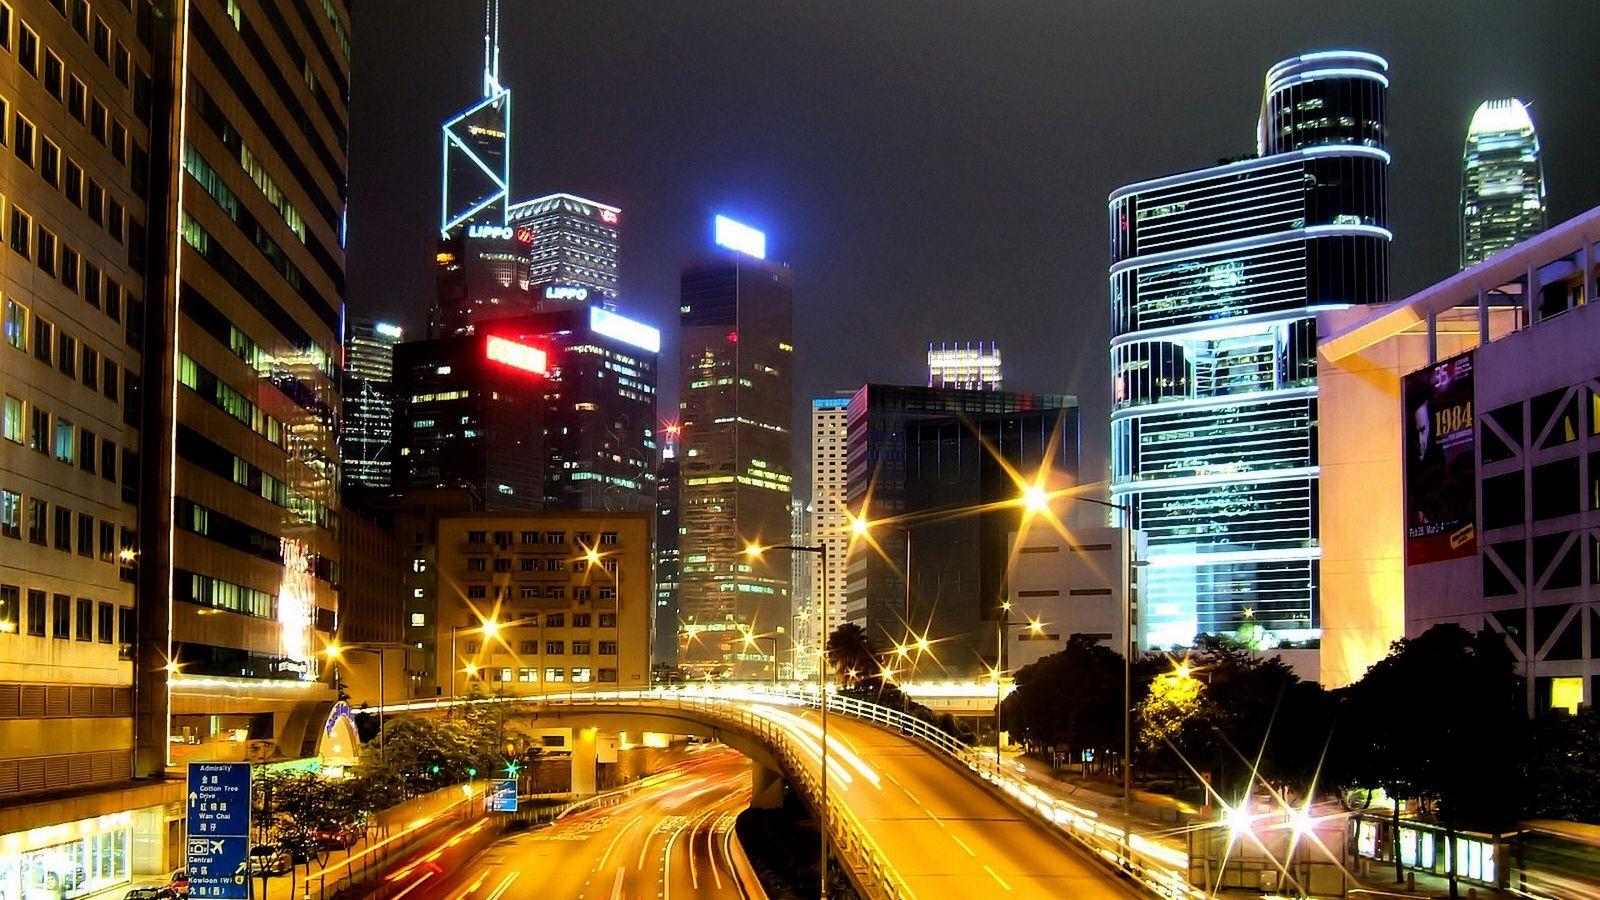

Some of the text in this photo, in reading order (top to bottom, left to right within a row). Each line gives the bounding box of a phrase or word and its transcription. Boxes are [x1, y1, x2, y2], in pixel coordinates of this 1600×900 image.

[469, 225, 514, 240] LIPPO
[545, 286, 588, 301] LIPPO
[1435, 401, 1473, 437] 1984
[199, 812, 230, 820] Wan Chai
